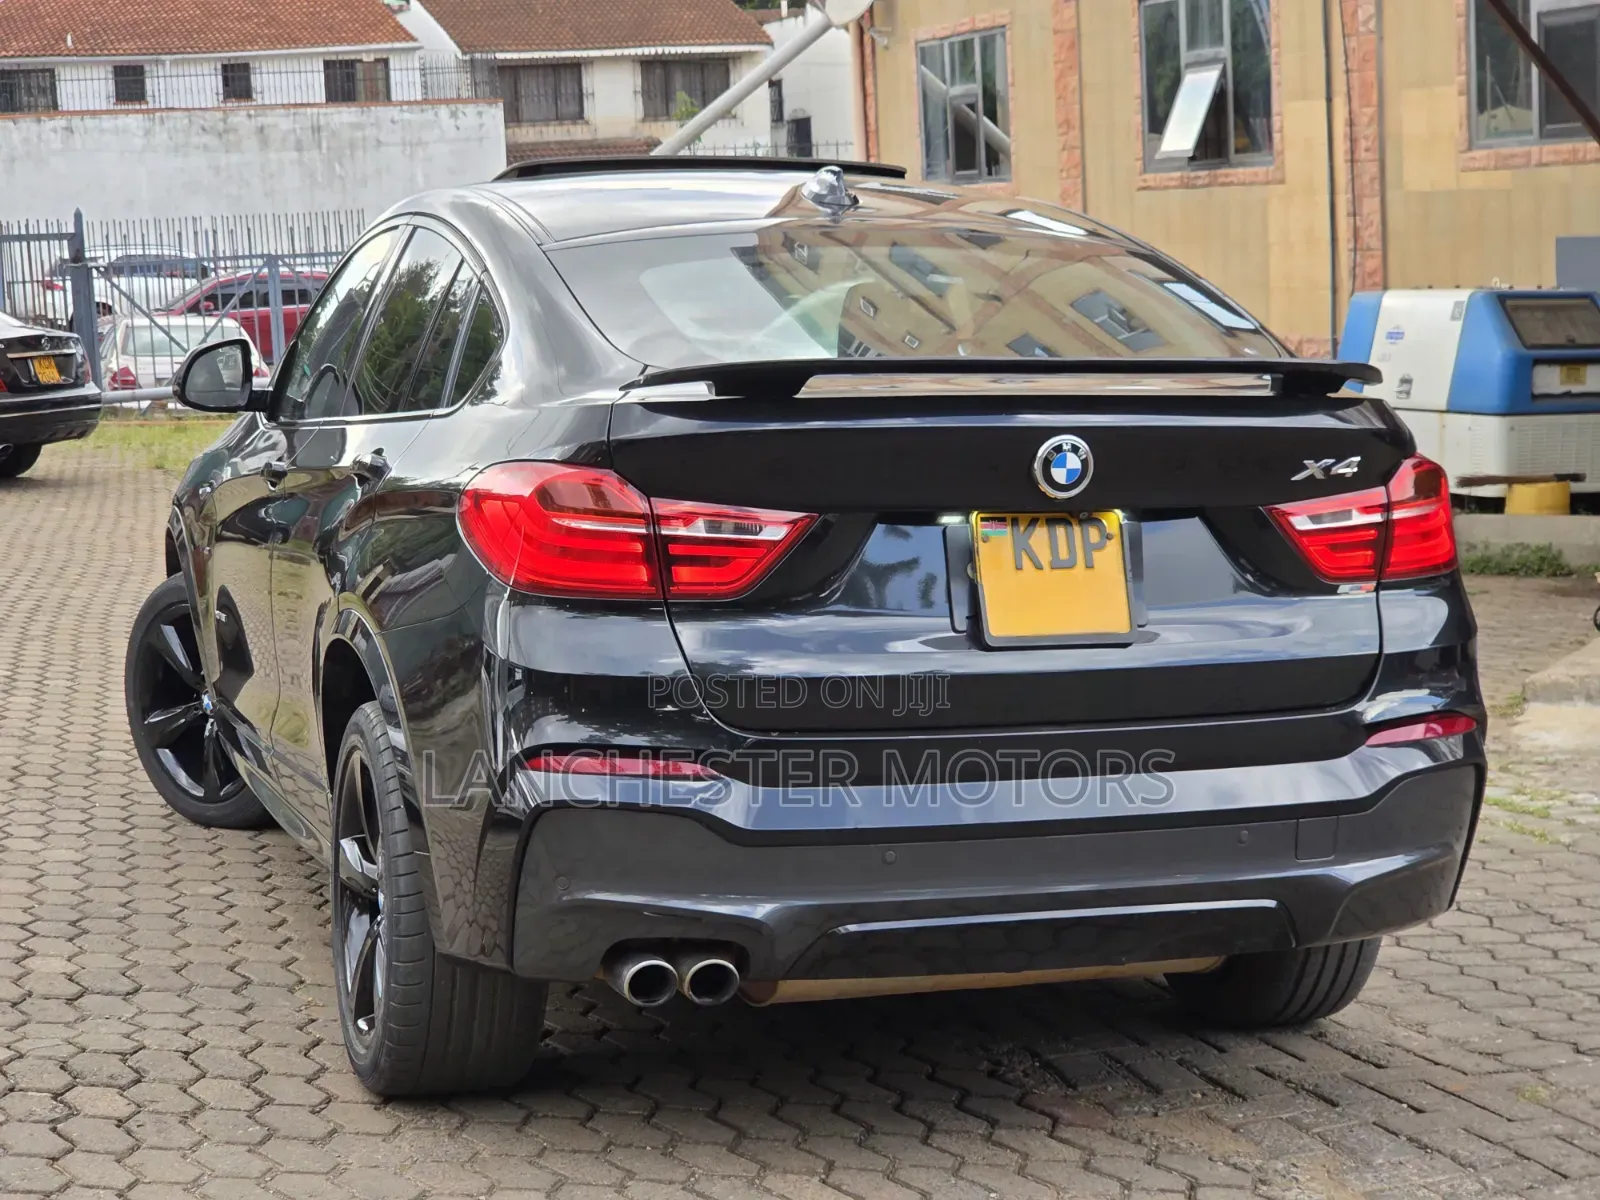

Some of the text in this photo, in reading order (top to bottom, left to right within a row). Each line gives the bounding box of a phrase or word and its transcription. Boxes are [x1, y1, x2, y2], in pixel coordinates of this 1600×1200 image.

[1046, 441, 1088, 461] BMW
[1290, 456, 1361, 481] X4
[1010, 517, 1108, 570] KDP
